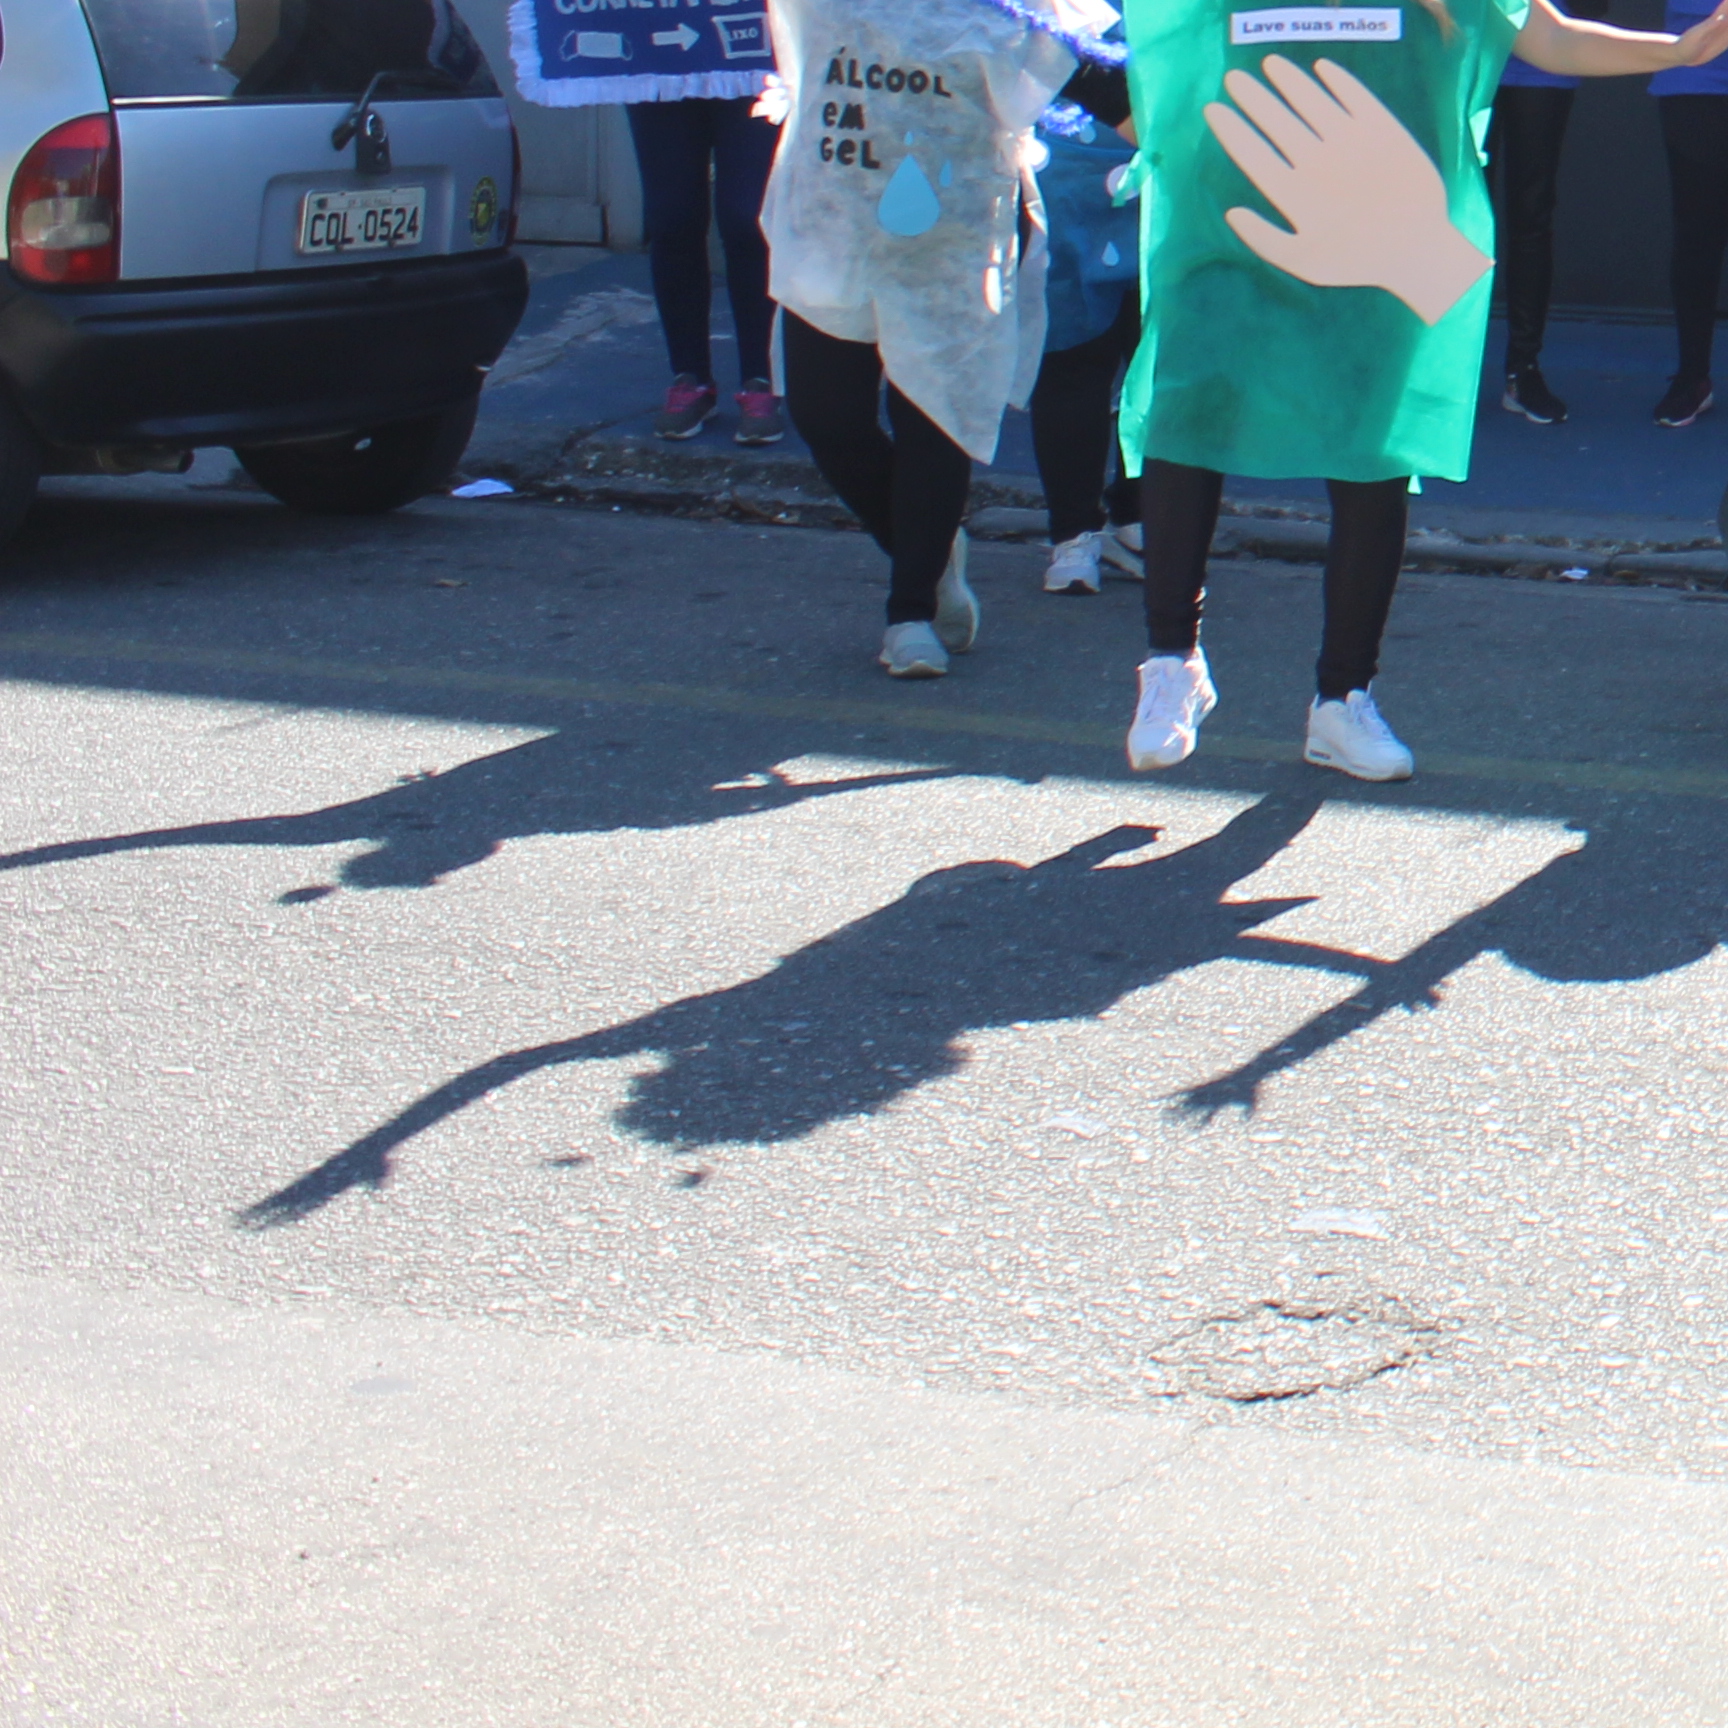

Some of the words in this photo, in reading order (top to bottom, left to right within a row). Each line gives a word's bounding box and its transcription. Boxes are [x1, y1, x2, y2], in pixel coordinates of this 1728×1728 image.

[1242, 21, 1286, 34] Lave
[1290, 20, 1334, 32] suas
[1339, 18, 1388, 32] mãos
[826, 46, 952, 98] ÁLCOOL
